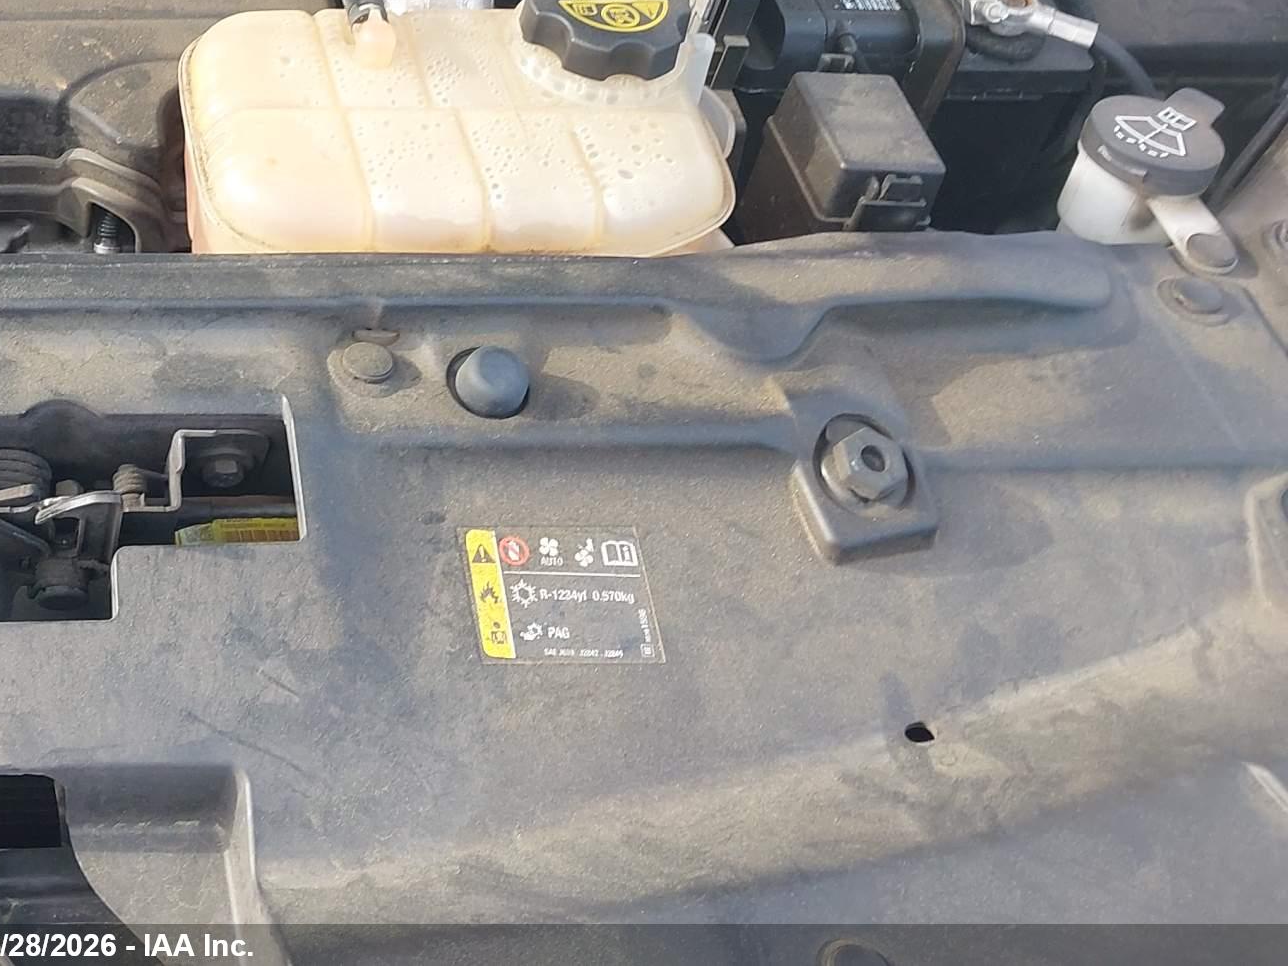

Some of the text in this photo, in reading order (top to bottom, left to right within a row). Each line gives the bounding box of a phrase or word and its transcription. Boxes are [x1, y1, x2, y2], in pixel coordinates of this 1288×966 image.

[540, 556, 564, 566] AUTO
[539, 588, 635, 605] R-1234yf 0.570kg
[547, 626, 571, 639] PAG
